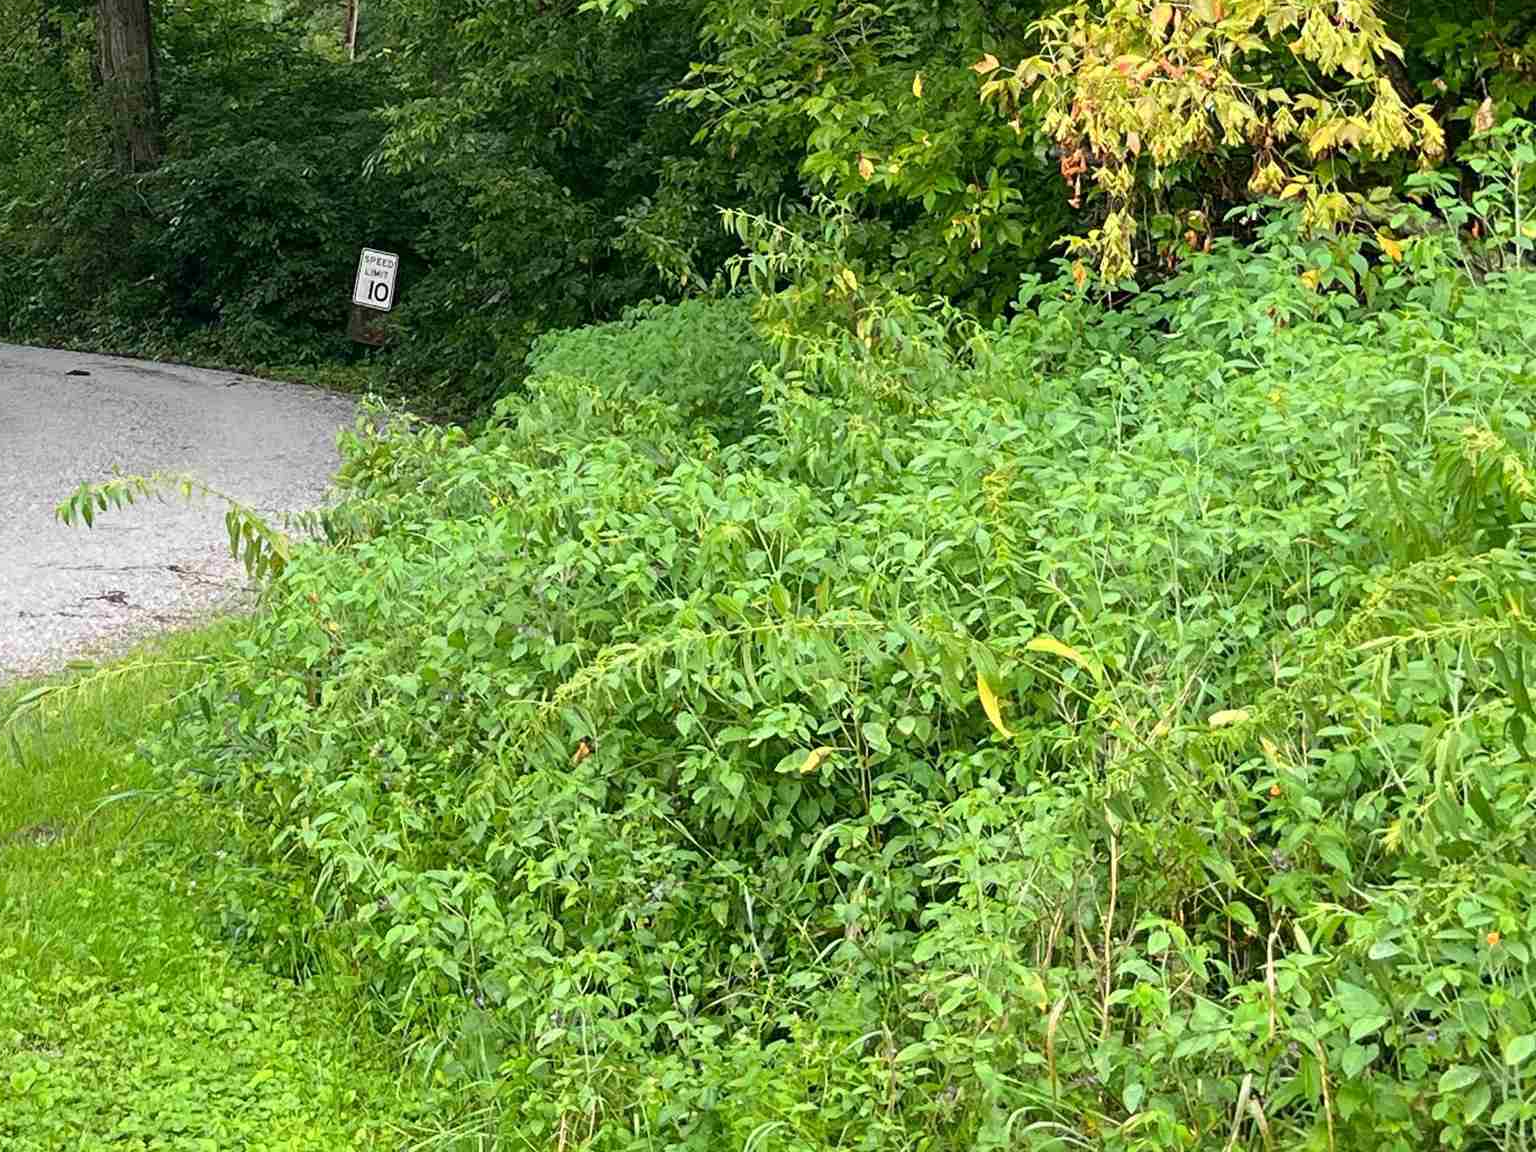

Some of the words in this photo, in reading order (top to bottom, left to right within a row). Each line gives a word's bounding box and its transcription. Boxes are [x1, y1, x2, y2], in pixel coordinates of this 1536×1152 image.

[365, 255, 394, 268] SPEED
[364, 269, 389, 279] LIMIT
[368, 281, 389, 302] 10
